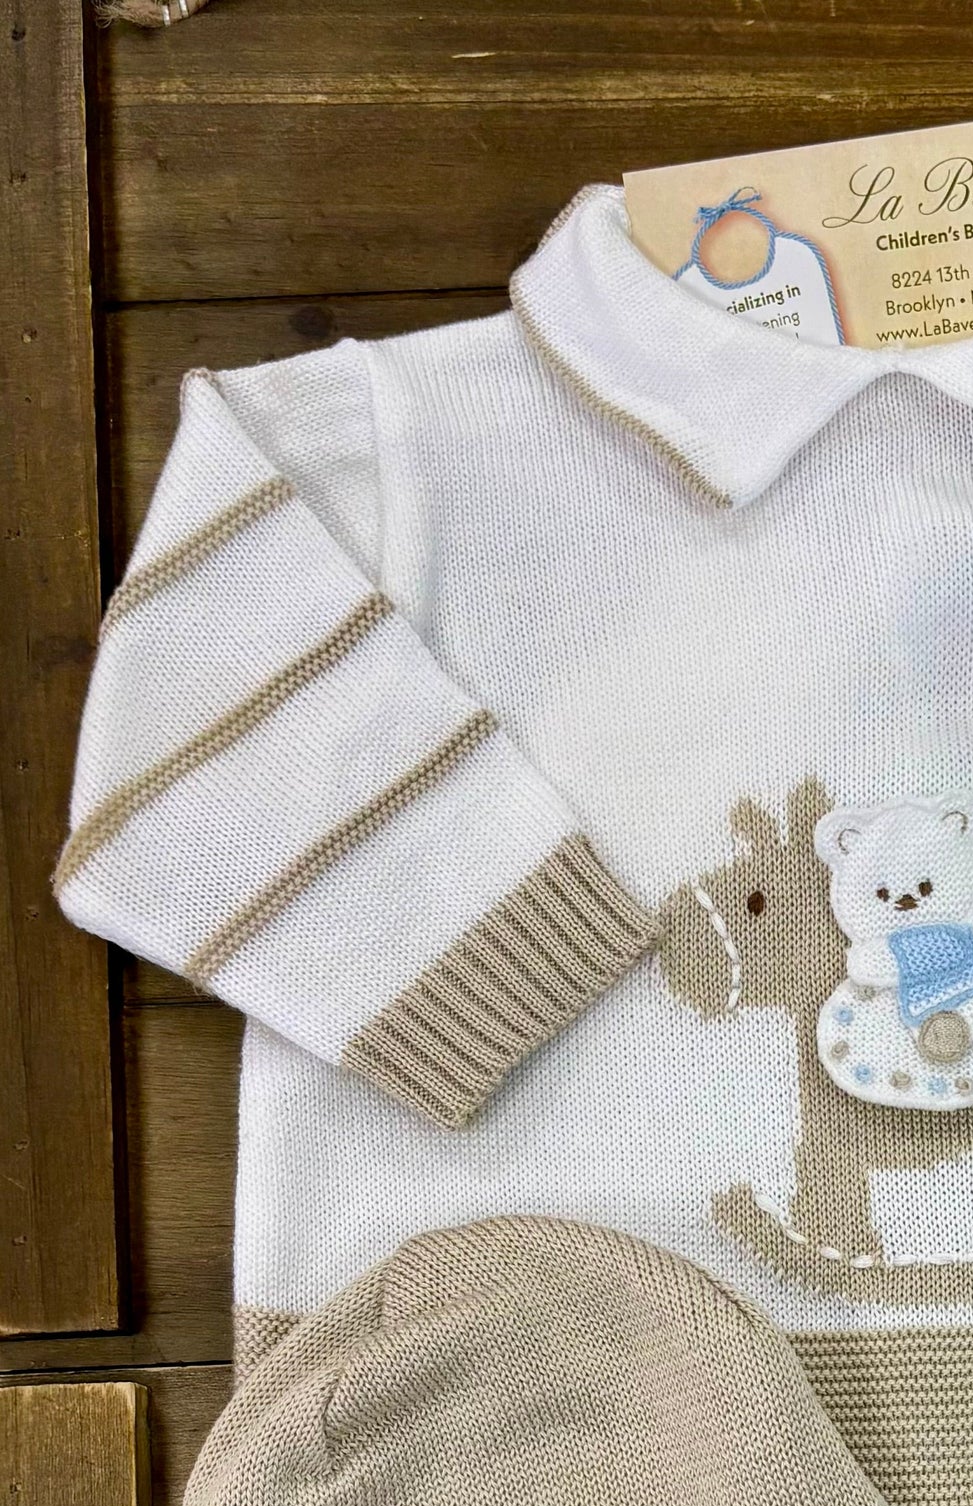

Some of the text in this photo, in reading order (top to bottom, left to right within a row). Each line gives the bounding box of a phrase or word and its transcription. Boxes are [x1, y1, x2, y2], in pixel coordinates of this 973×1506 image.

[822, 164, 904, 228] La
[876, 226, 960, 251] Children's
[891, 269, 932, 289] 8224
[936, 264, 970, 283] 13th
[727, 285, 801, 315] cializing in
[885, 294, 956, 316] Brooklyn
[762, 311, 801, 330] ening
